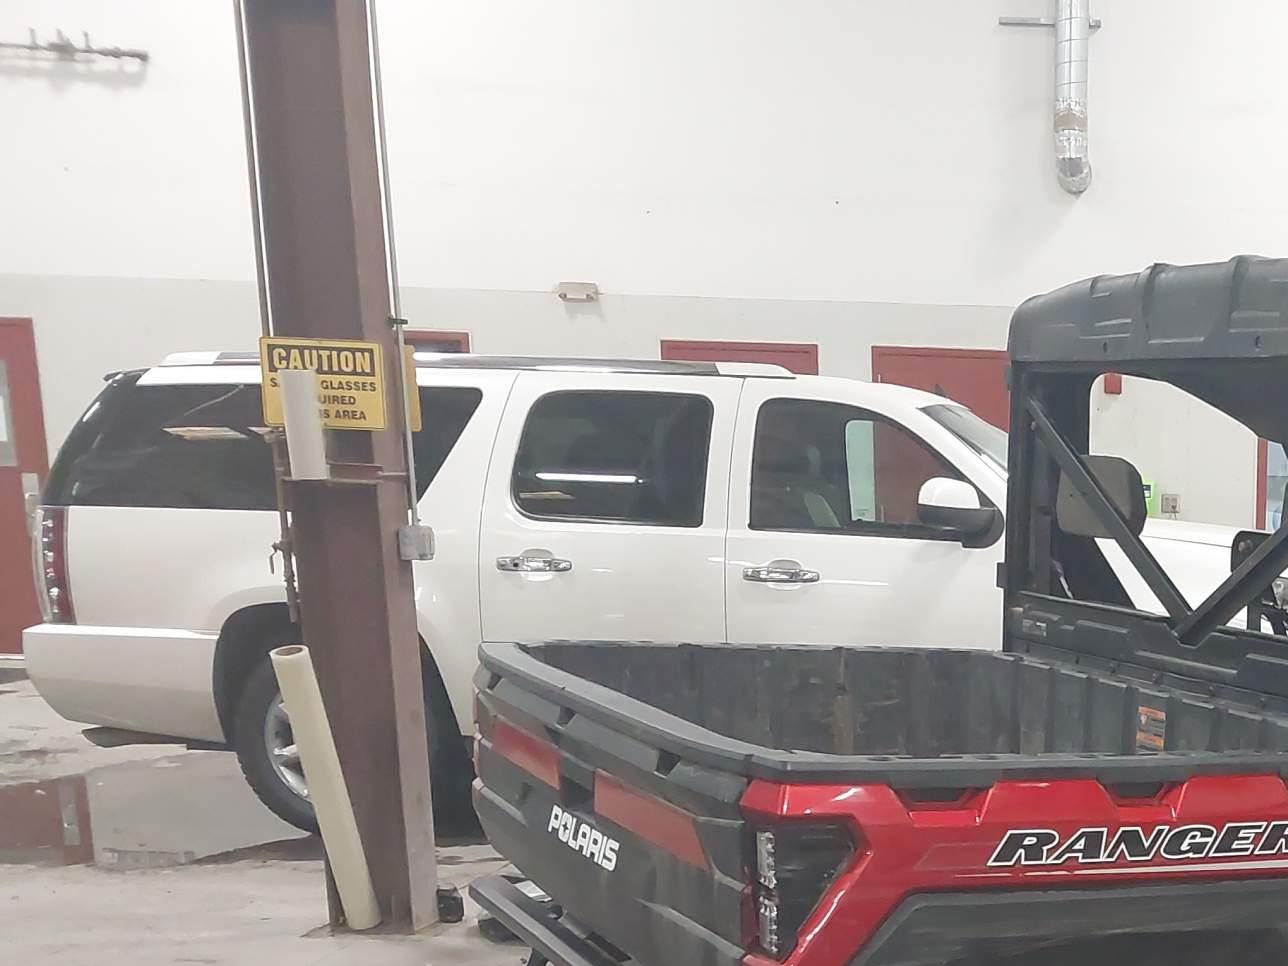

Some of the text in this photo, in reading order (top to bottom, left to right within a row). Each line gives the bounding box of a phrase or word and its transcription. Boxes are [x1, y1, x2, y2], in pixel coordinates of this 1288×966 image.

[272, 347, 371, 373] CAUTION
[320, 379, 377, 392] GLASSES
[318, 394, 356, 406] UIRED
[334, 410, 367, 421] AREA
[548, 804, 621, 872] POLARIS
